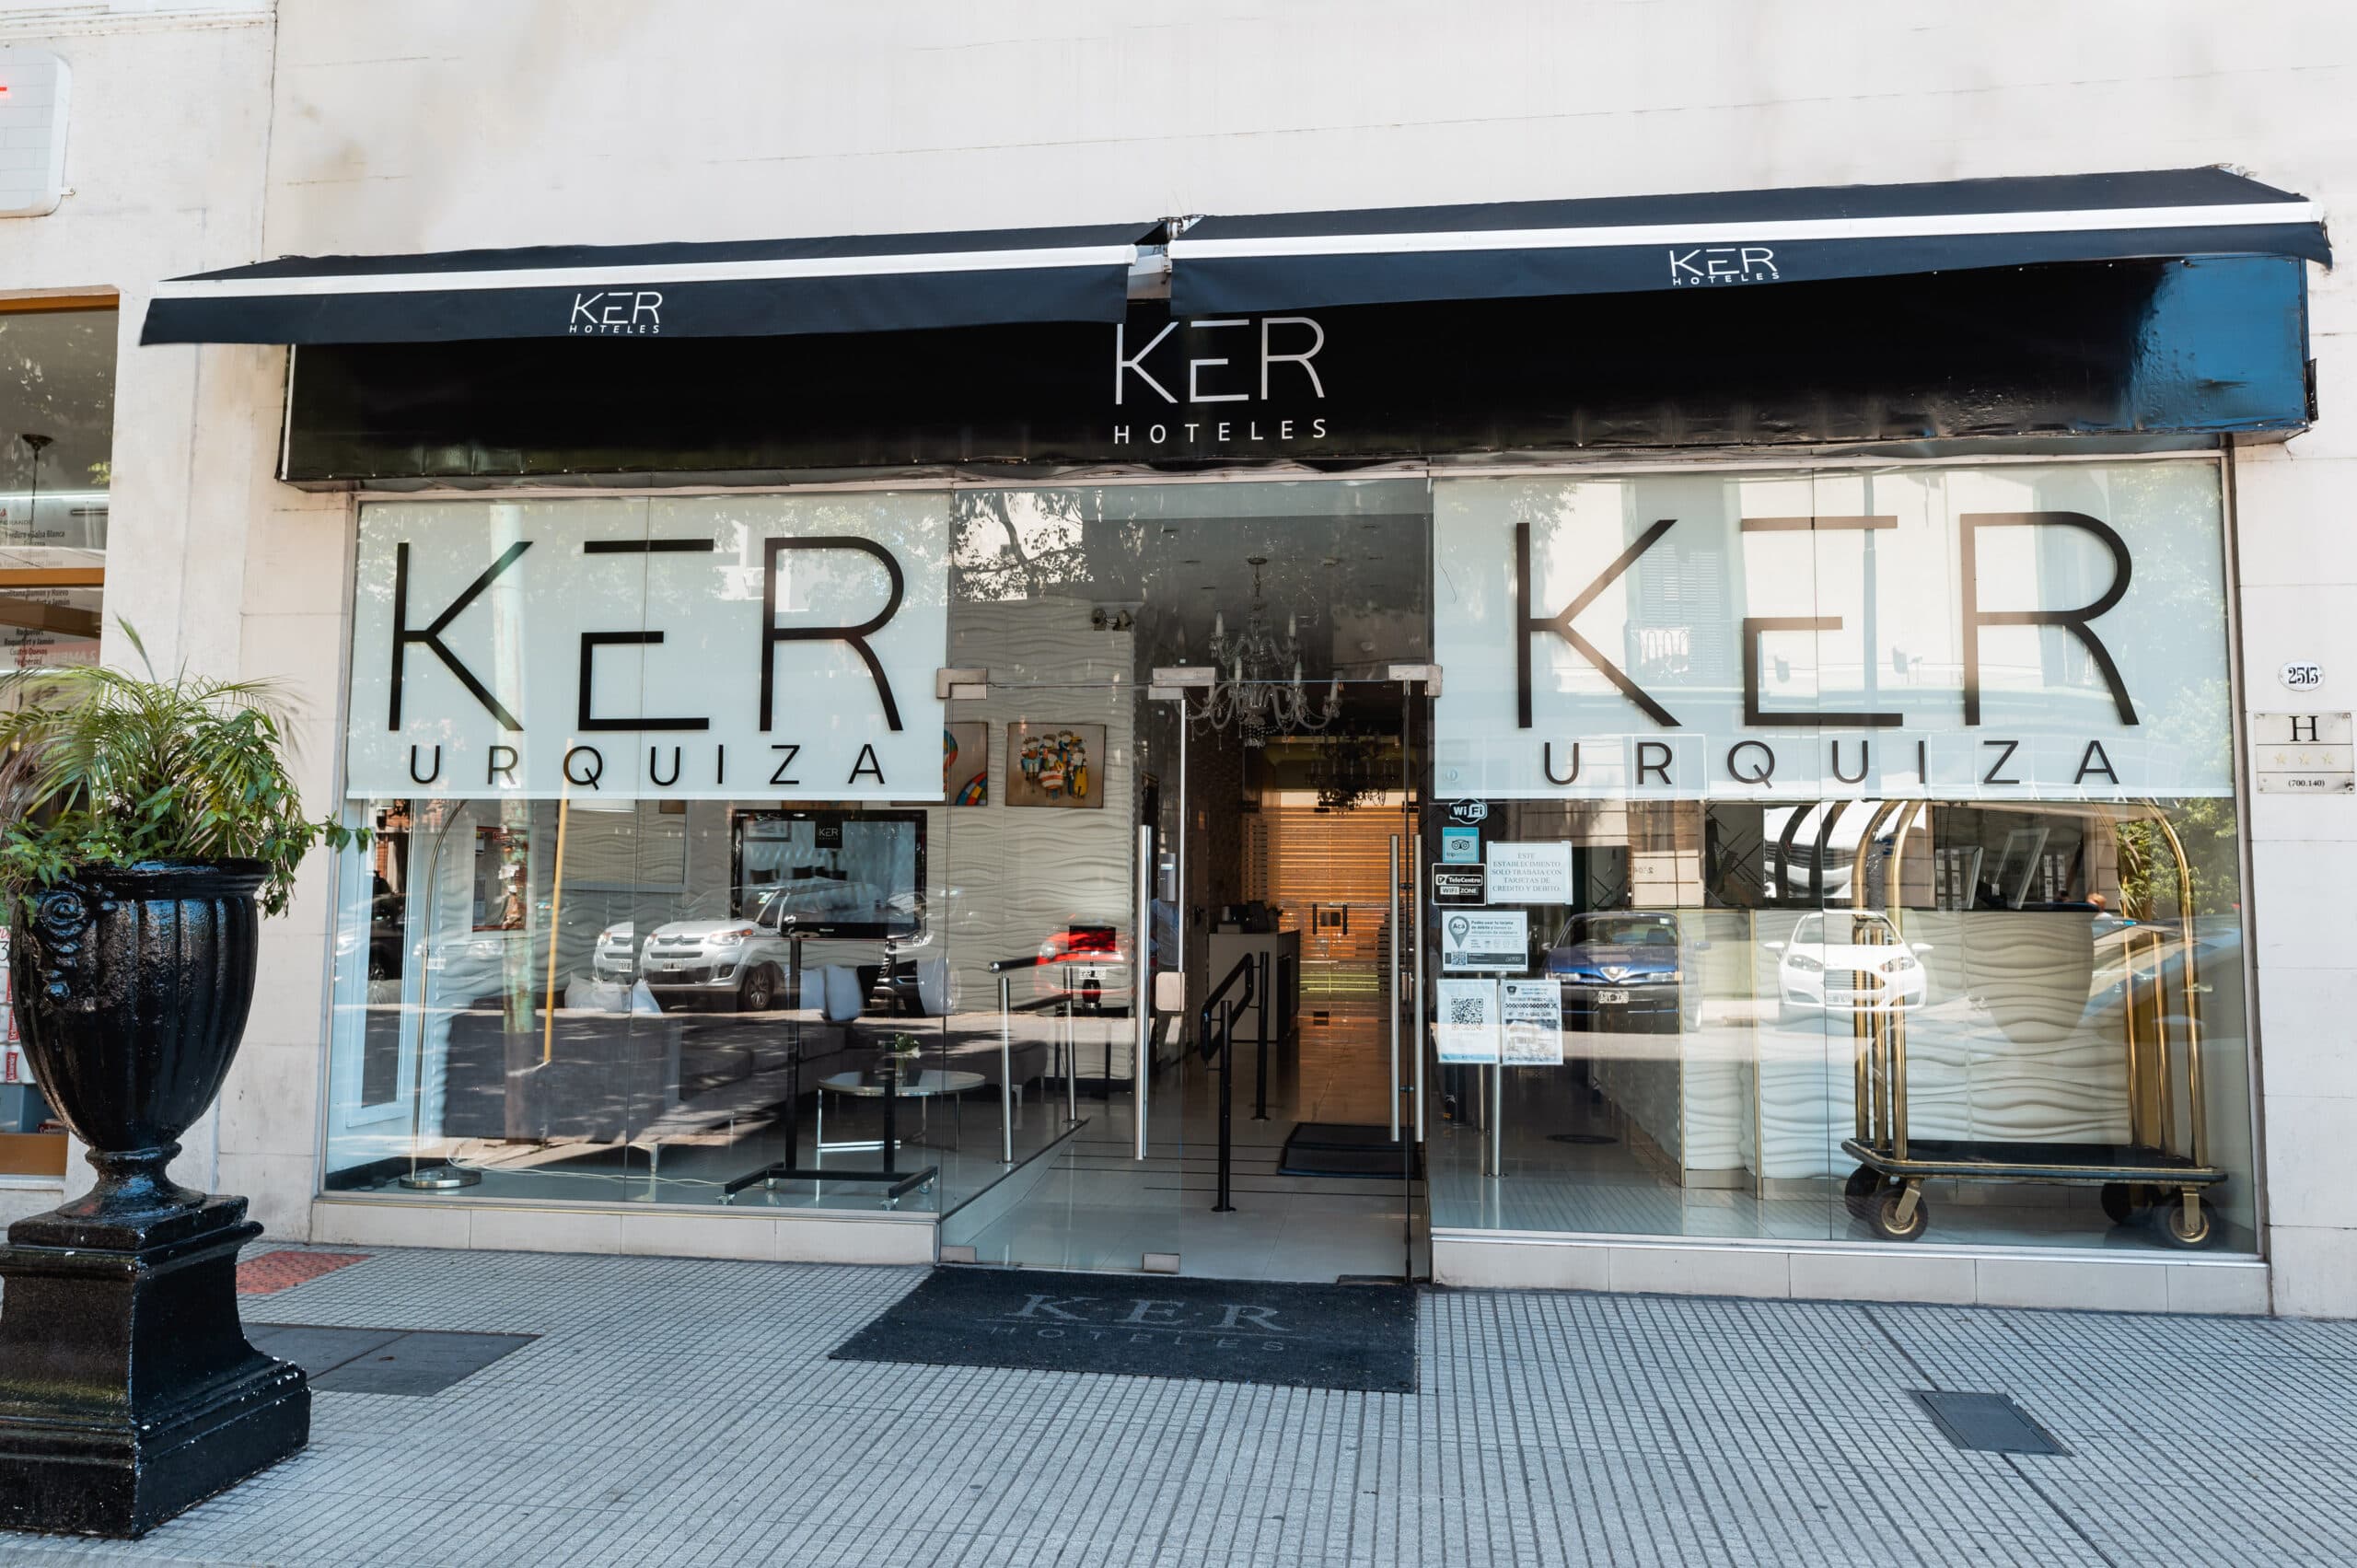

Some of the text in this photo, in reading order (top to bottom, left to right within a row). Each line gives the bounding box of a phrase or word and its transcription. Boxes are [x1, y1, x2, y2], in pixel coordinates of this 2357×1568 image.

[1669, 247, 1778, 277] KER
[1673, 273, 1780, 286] HOTELES
[571, 291, 663, 324] KER
[569, 324, 660, 334] HOTELES
[1115, 317, 1326, 405] KER
[1114, 419, 1326, 445] HOTELES
[389, 535, 905, 732] KER
[1515, 510, 2140, 728] KER
[2288, 715, 2320, 742] H
[410, 743, 886, 791] URQUIZA
[1544, 739, 2120, 790] URQUIZA
[819, 828, 839, 837] KER
[1004, 1294, 1294, 1332] KER
